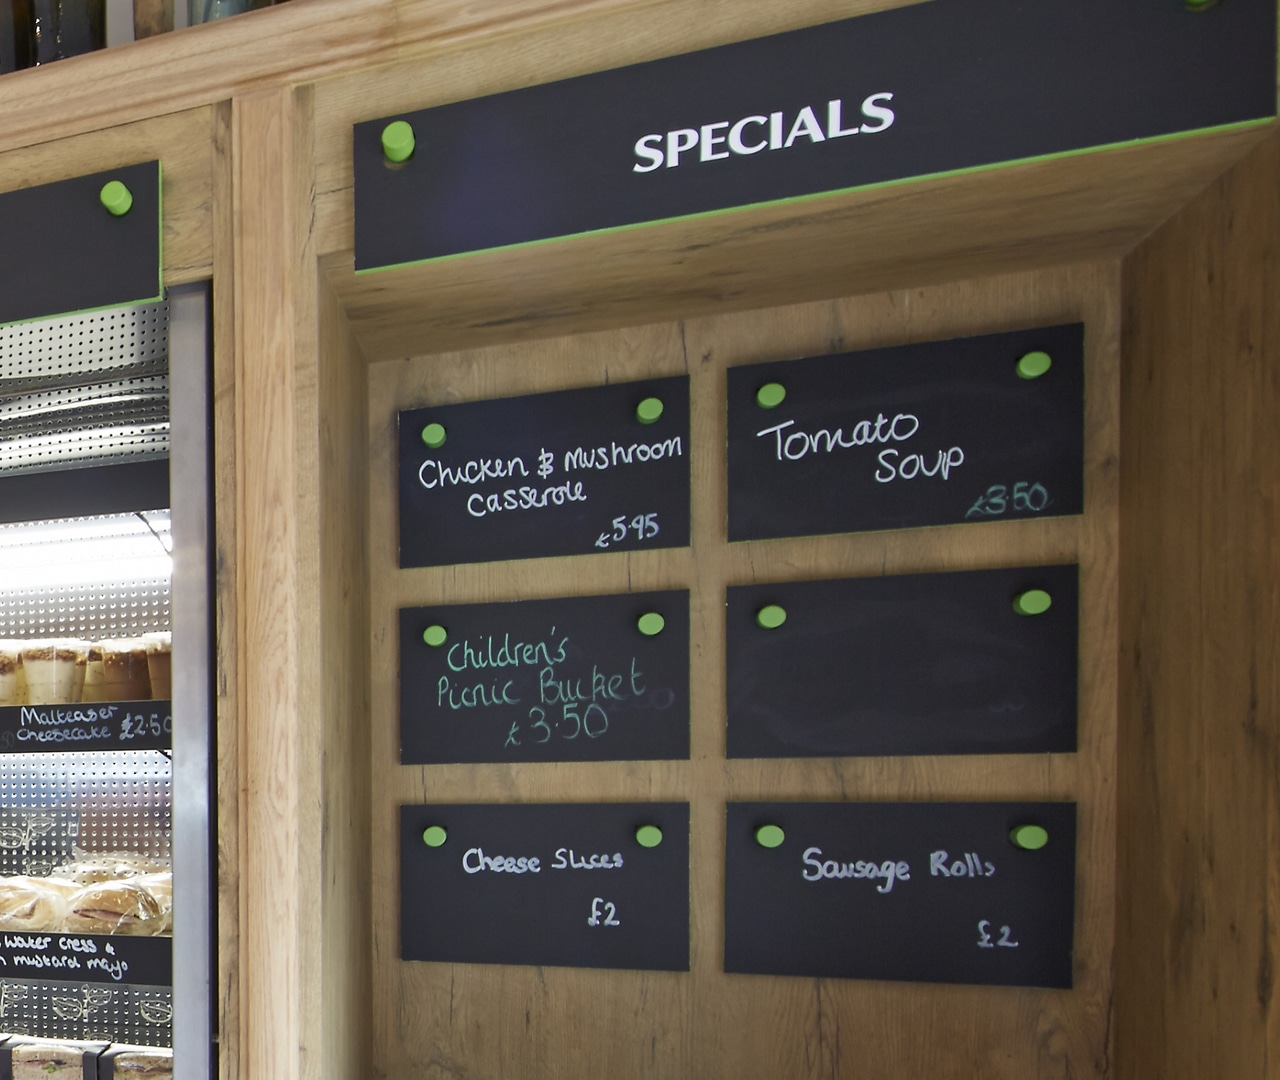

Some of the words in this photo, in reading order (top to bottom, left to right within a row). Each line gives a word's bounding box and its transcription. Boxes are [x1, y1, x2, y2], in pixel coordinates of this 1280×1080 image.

[632, 91, 897, 175] SPECIALS
[756, 413, 920, 461] Tomato
[418, 456, 530, 490] Chicken
[874, 446, 966, 484] Soup
[447, 625, 569, 673] Children's
[438, 675, 522, 710] Picnic
[539, 656, 647, 706] Bucket
[20, 705, 120, 727] Malteaser
[462, 847, 542, 875] Cheese
[801, 846, 912, 894] Sausage
[929, 849, 997, 879] Rolls
[586, 897, 621, 928] £2
[975, 918, 1021, 950] £2
[13, 953, 82, 970] mustard
[86, 956, 130, 981] mayo
